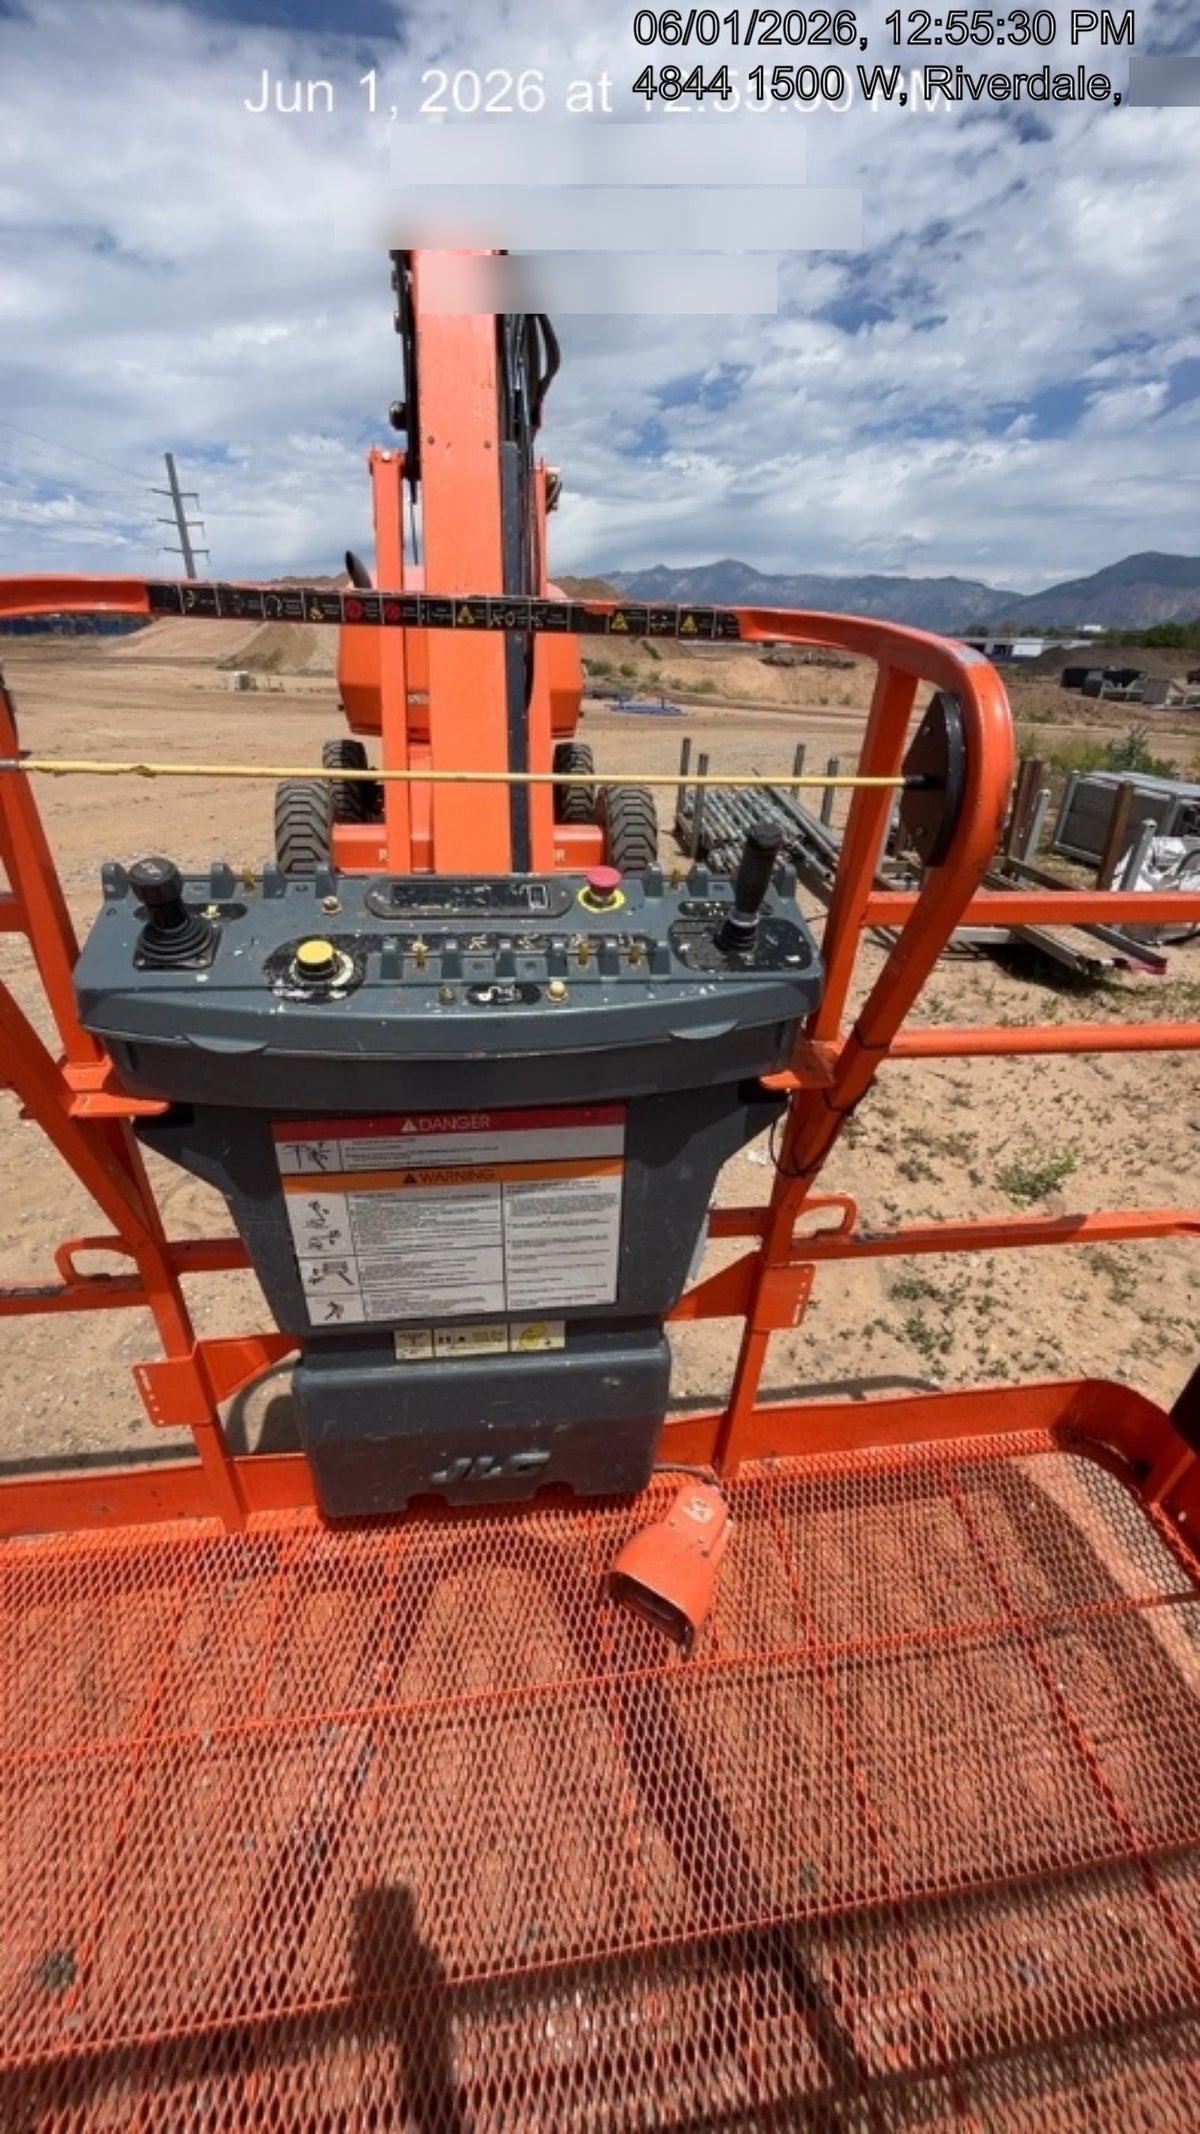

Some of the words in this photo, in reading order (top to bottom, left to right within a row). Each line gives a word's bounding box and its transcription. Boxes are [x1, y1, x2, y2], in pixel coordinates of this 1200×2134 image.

[419, 1113, 491, 1132] DANGER
[419, 1168, 495, 1185] WARNING
[428, 1450, 551, 1482] JLG
